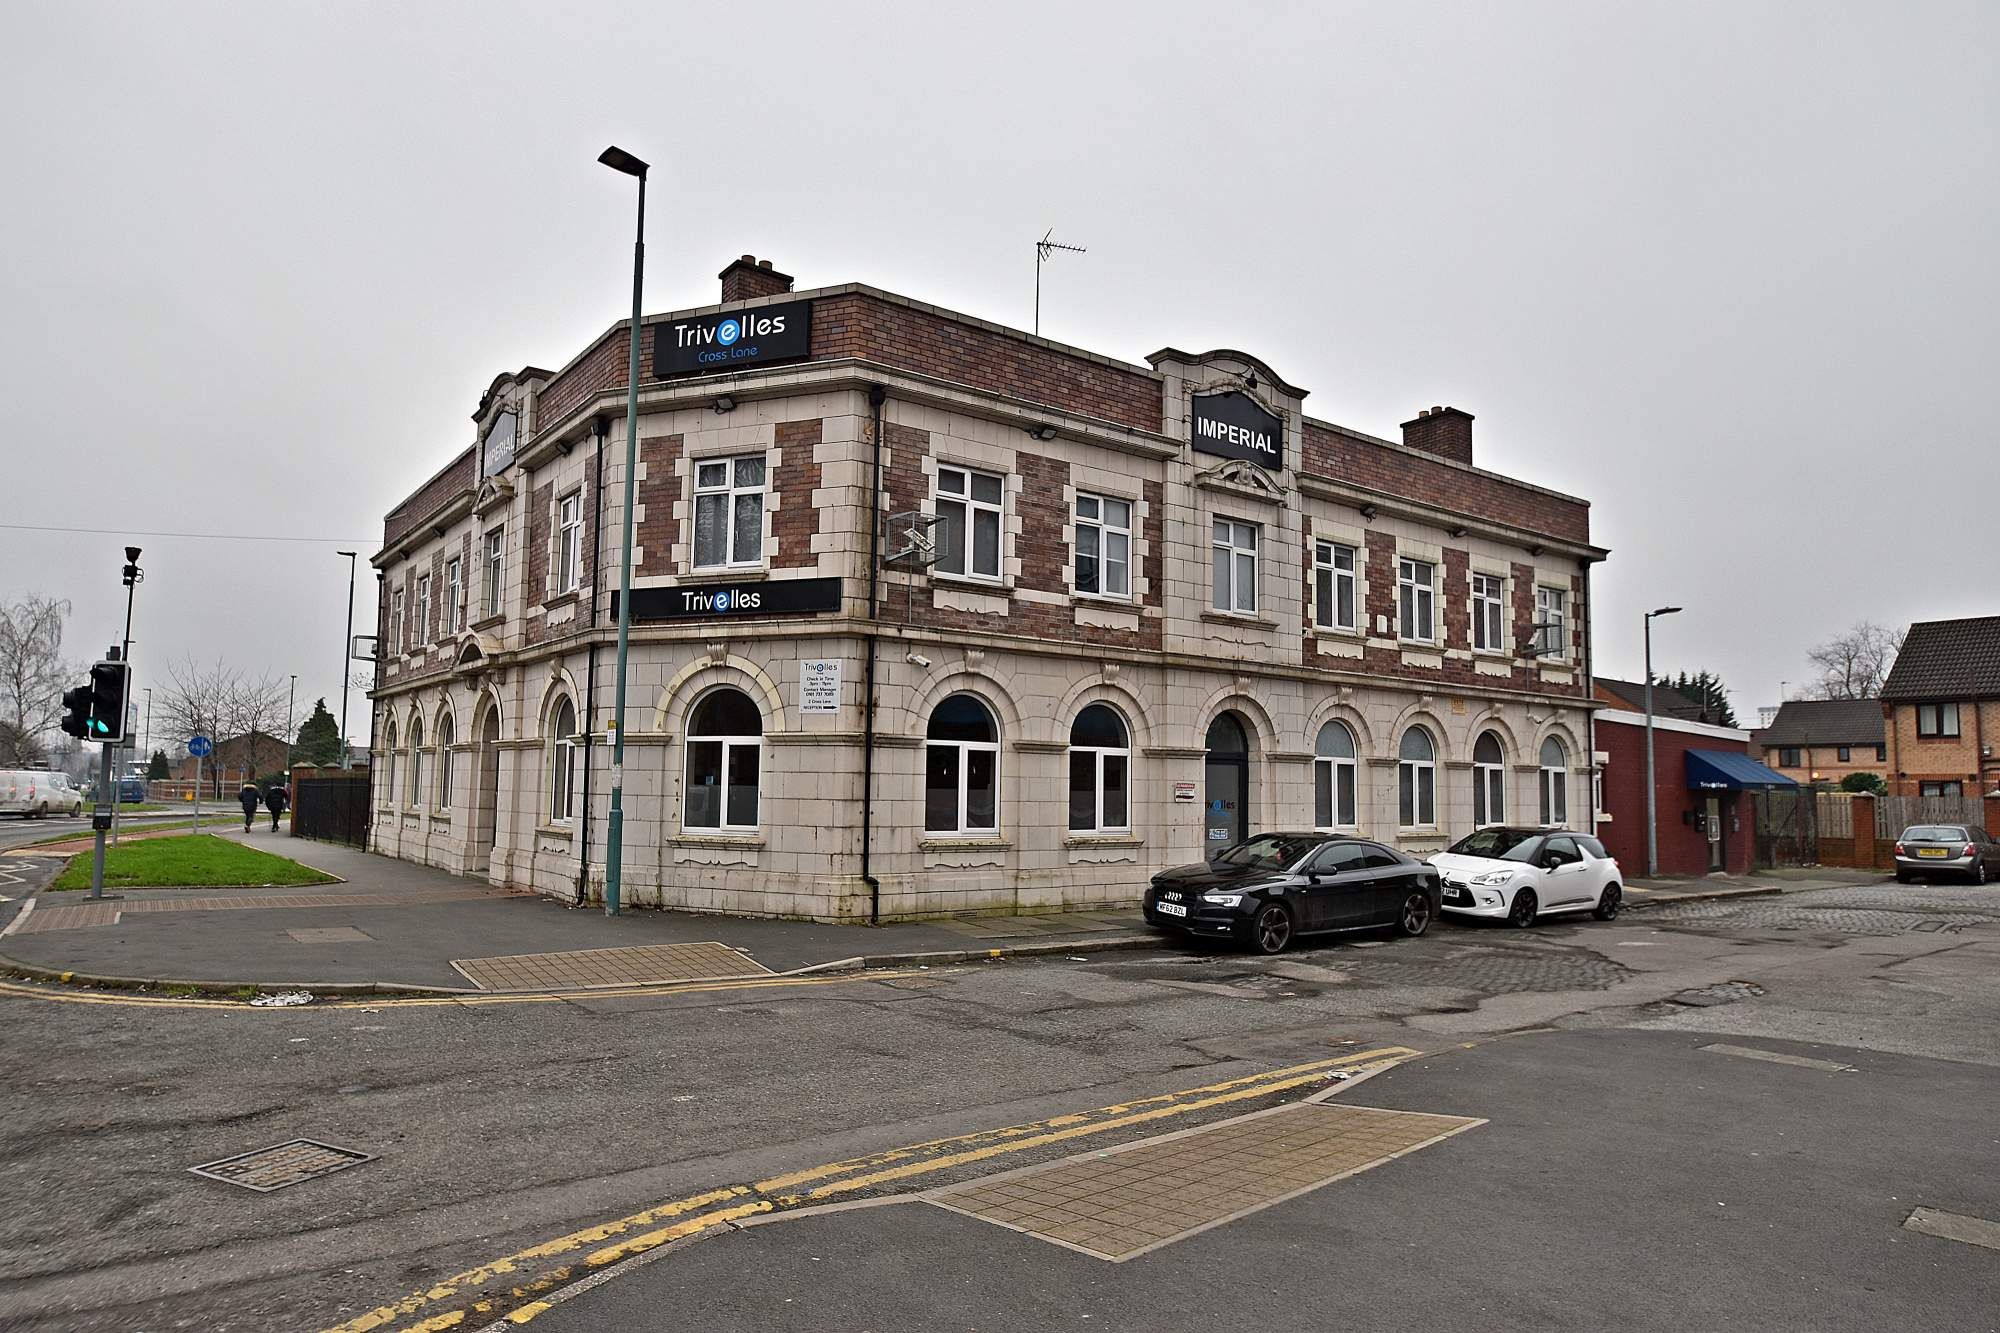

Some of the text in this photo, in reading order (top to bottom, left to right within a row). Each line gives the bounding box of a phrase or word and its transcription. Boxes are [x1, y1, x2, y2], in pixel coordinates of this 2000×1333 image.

[675, 314, 785, 347] Trivelles
[699, 347, 758, 362] Cross Lane
[1197, 416, 1276, 454] IMPERIAL
[682, 589, 760, 611] Trivelles
